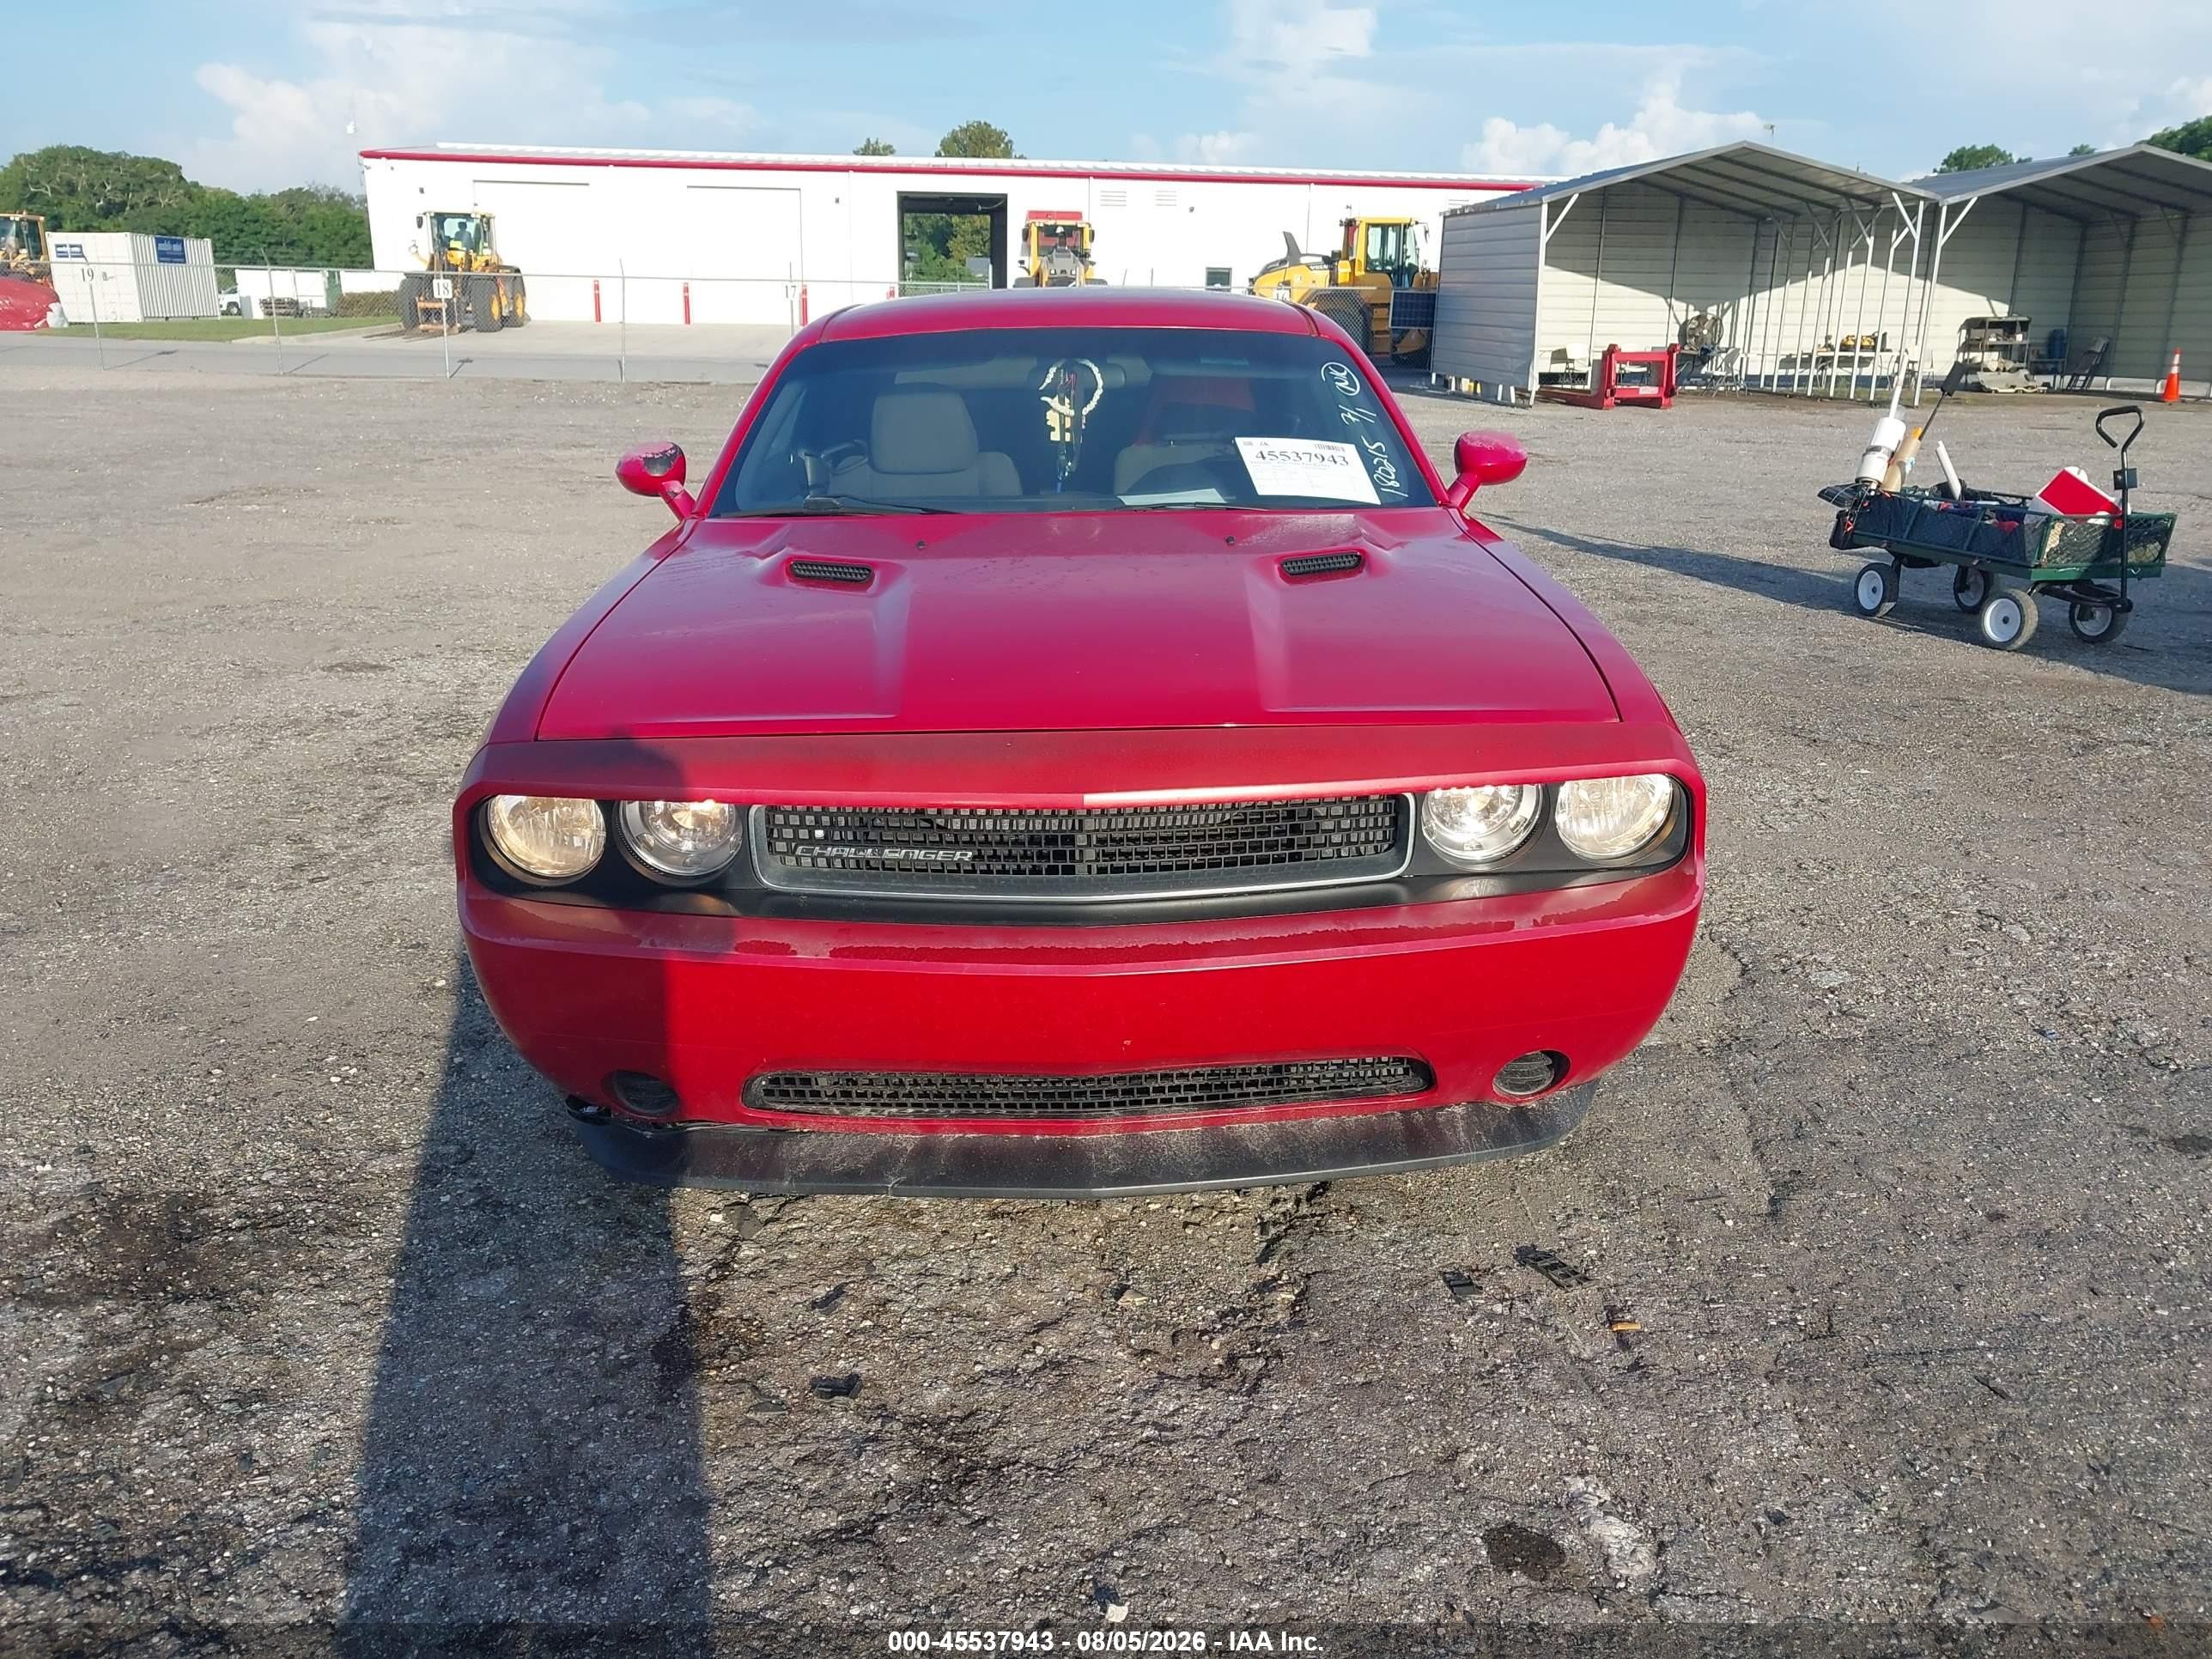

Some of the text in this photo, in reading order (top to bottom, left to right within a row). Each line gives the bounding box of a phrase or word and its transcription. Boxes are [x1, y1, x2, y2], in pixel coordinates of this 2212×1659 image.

[81, 267, 94, 282] 19
[436, 281, 450, 296] 18
[785, 284, 797, 298] 17
[1255, 449, 1350, 467] 45537943
[795, 844, 974, 861] CHALLENGER
